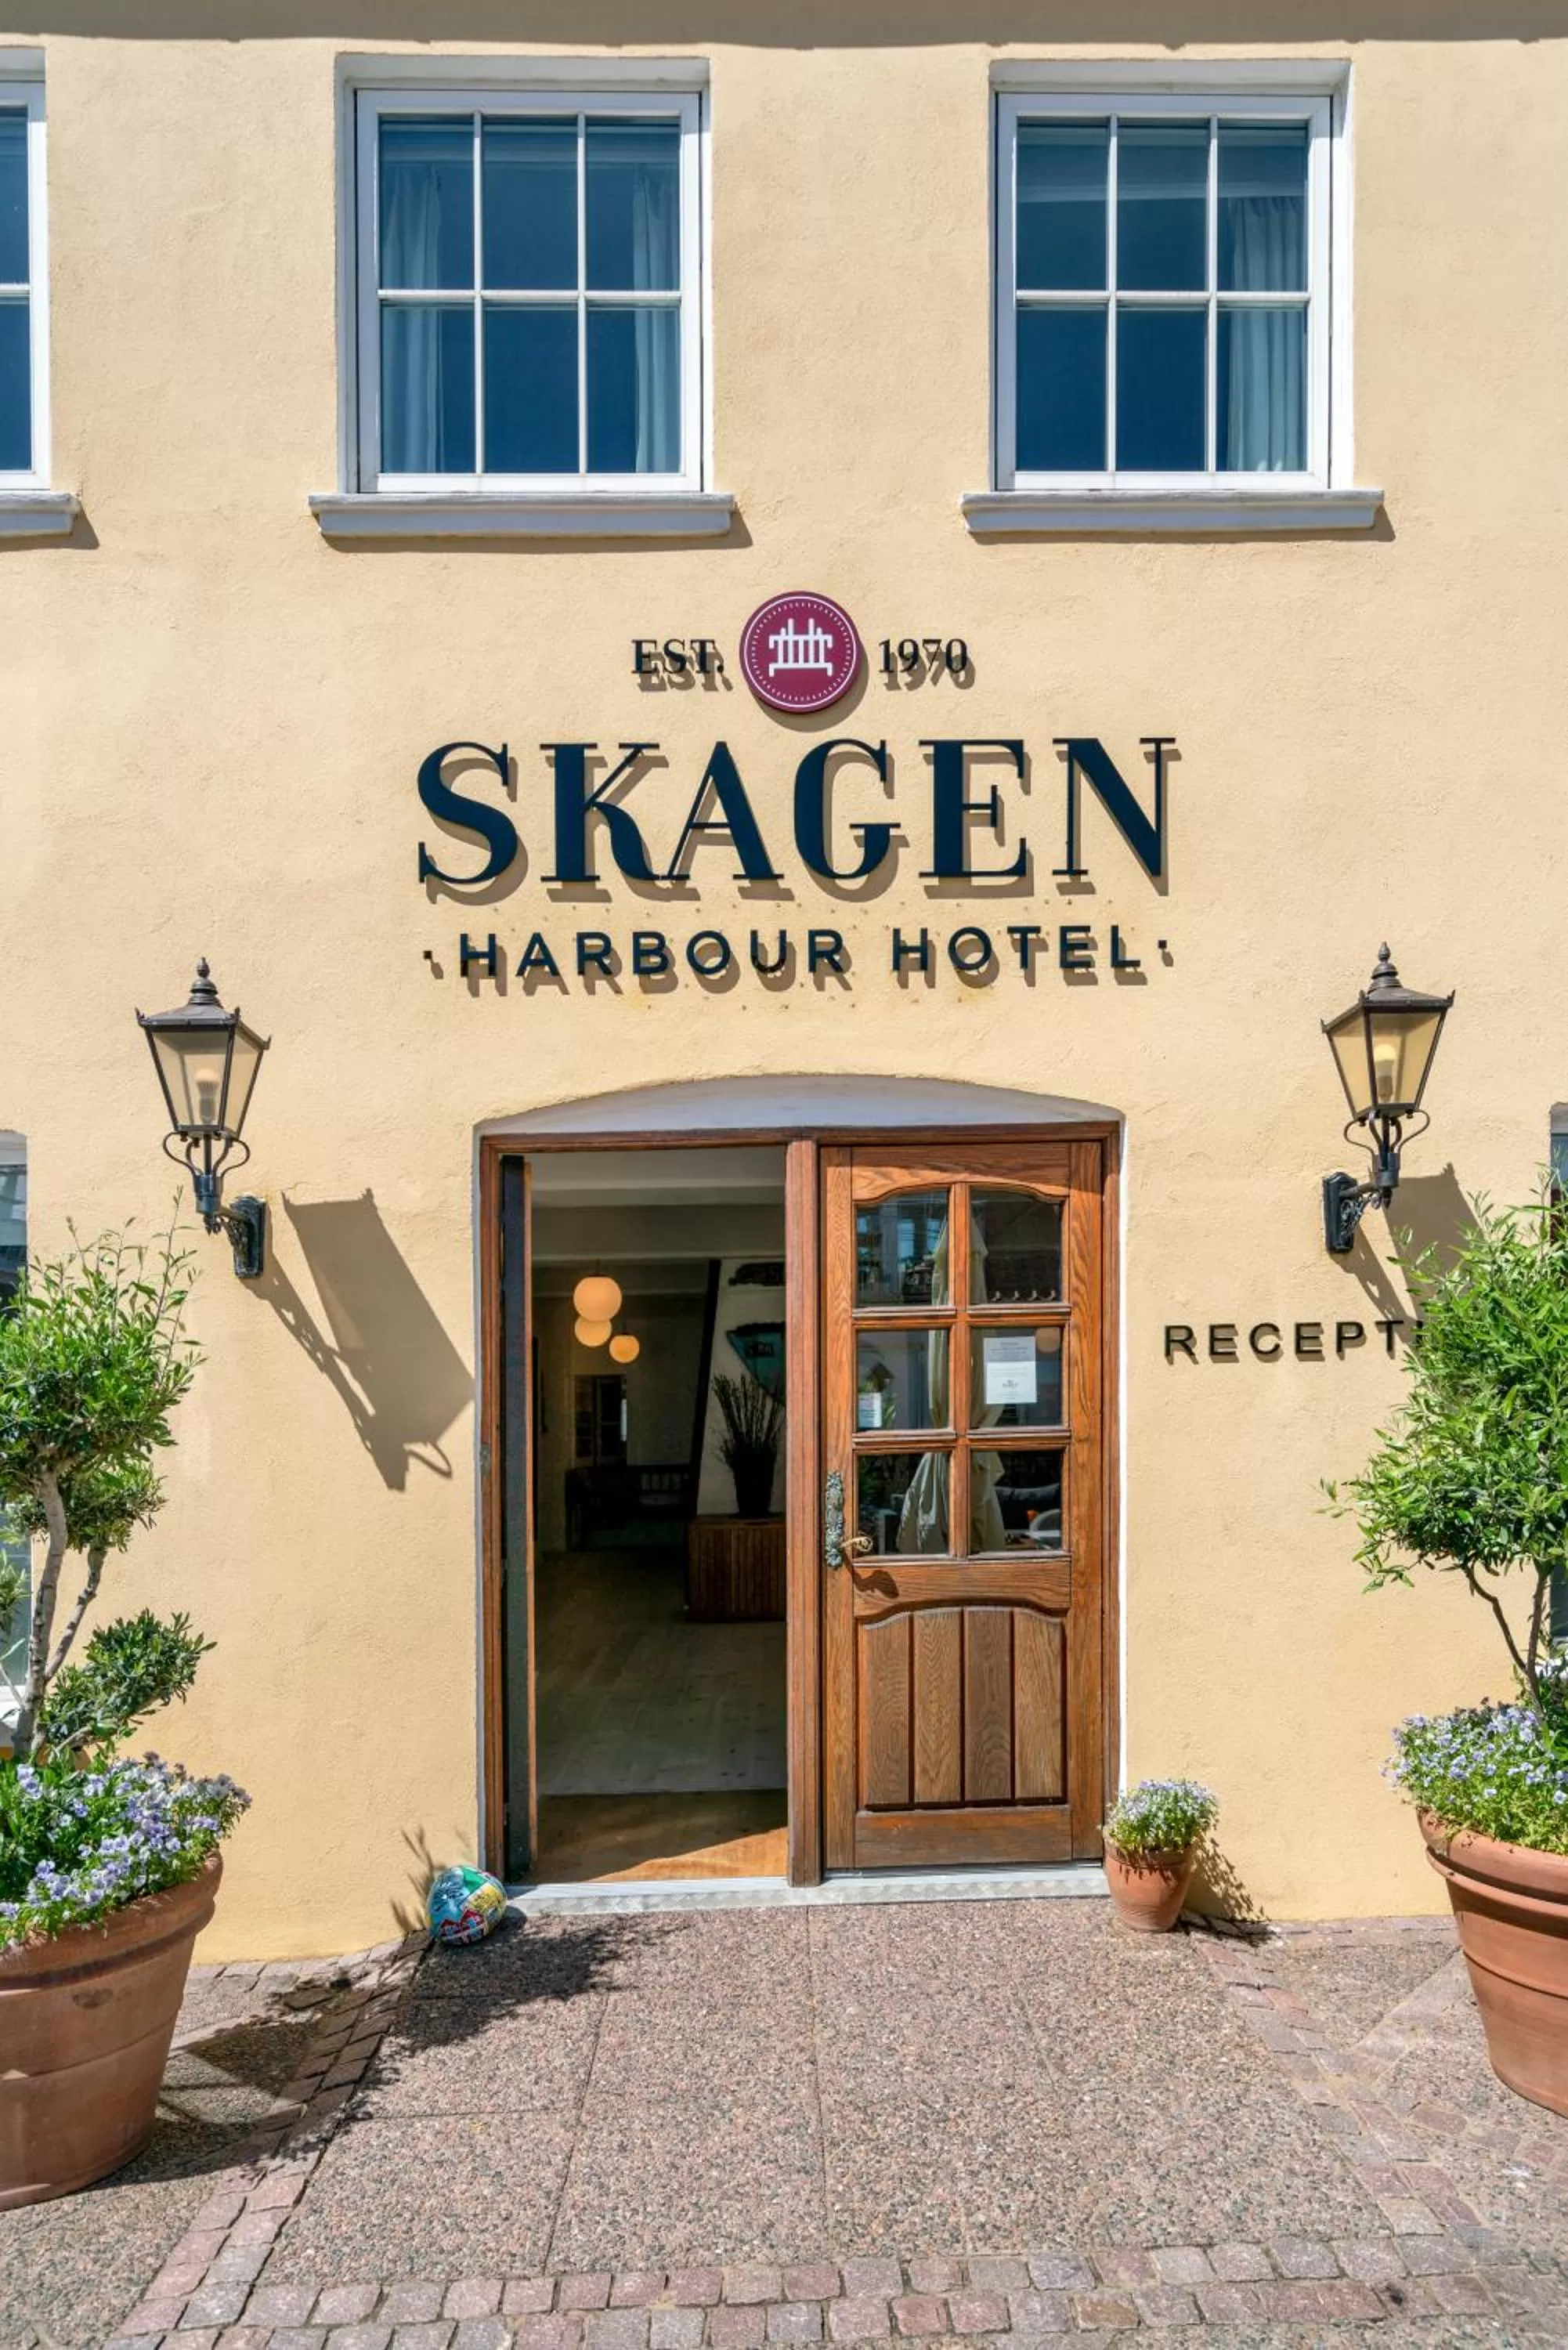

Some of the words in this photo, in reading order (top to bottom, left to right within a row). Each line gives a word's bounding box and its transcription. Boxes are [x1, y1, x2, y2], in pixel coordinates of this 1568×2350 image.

[632, 638, 724, 675] EST.
[879, 638, 968, 672] 1970
[417, 737, 1176, 884] SKAGEN
[460, 929, 844, 978] HARBOUR
[892, 925, 1141, 972] HOTEL
